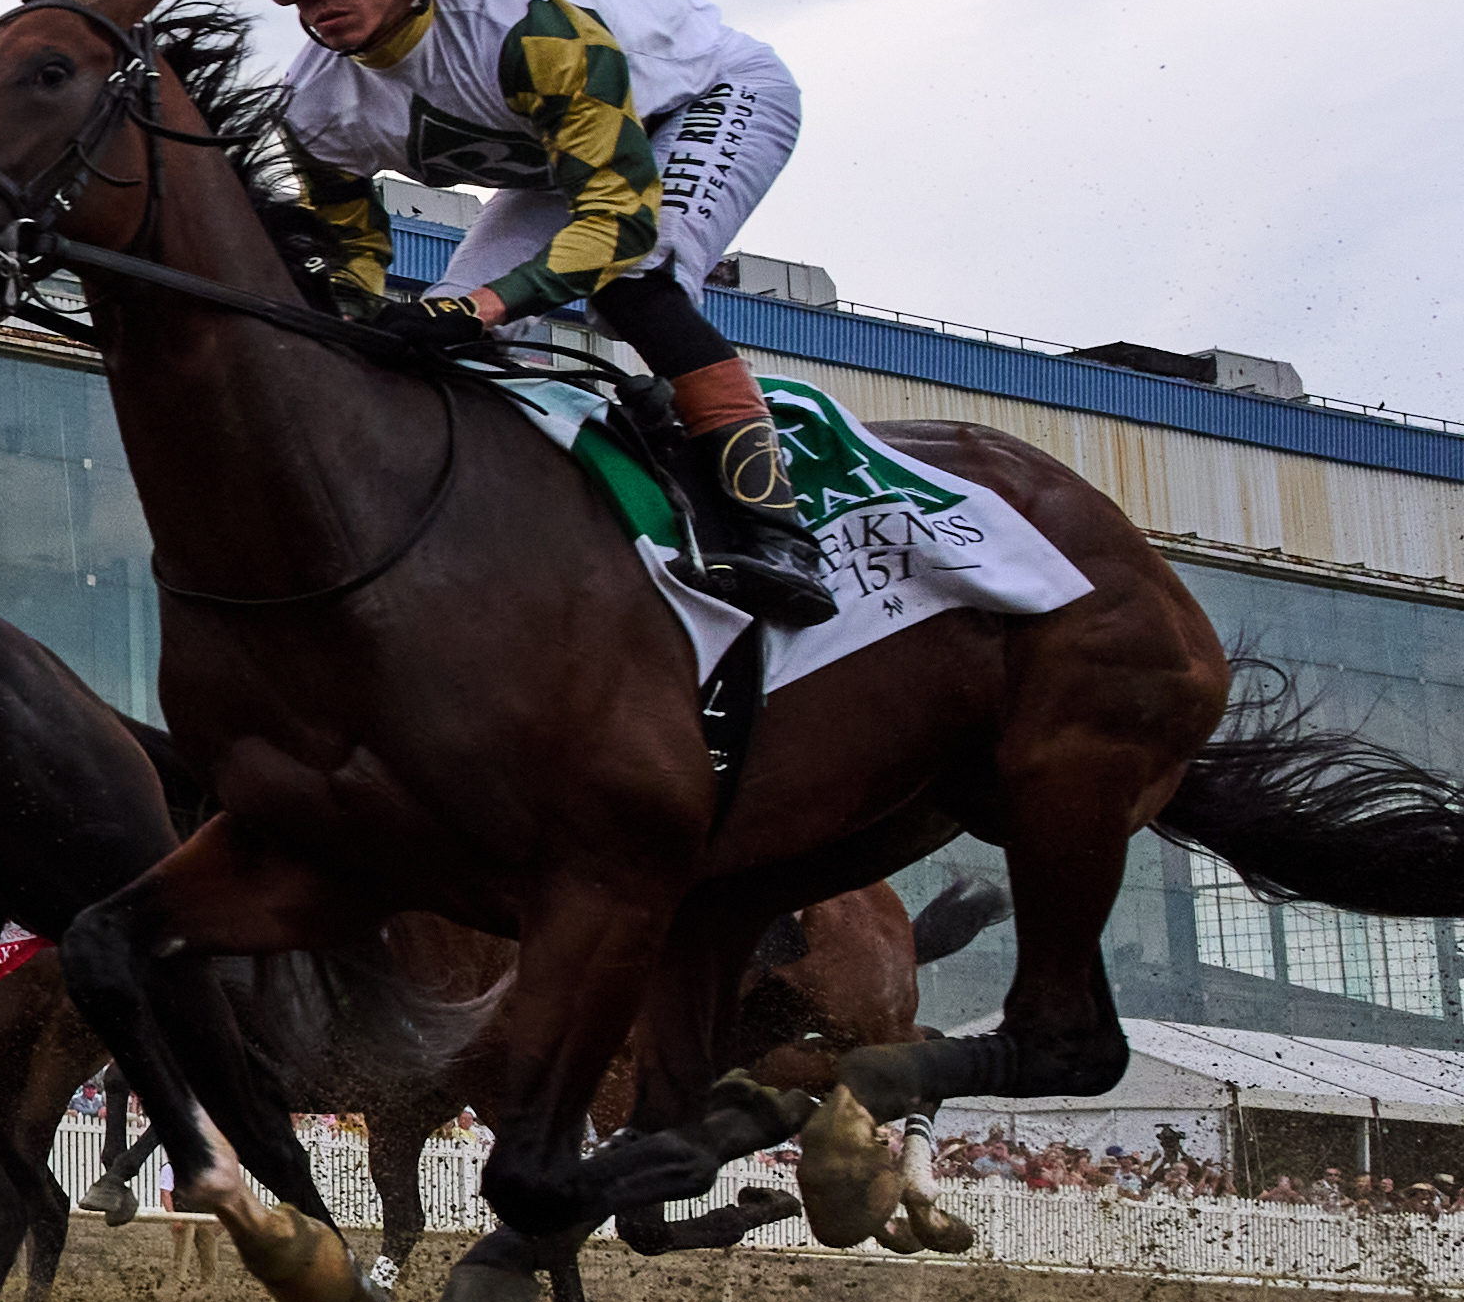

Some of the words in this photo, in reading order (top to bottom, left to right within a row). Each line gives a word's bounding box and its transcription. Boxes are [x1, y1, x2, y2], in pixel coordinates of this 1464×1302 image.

[661, 152, 706, 215] JEFF
[698, 86, 758, 219] STEAKHOUS
[846, 551, 915, 598] 151
